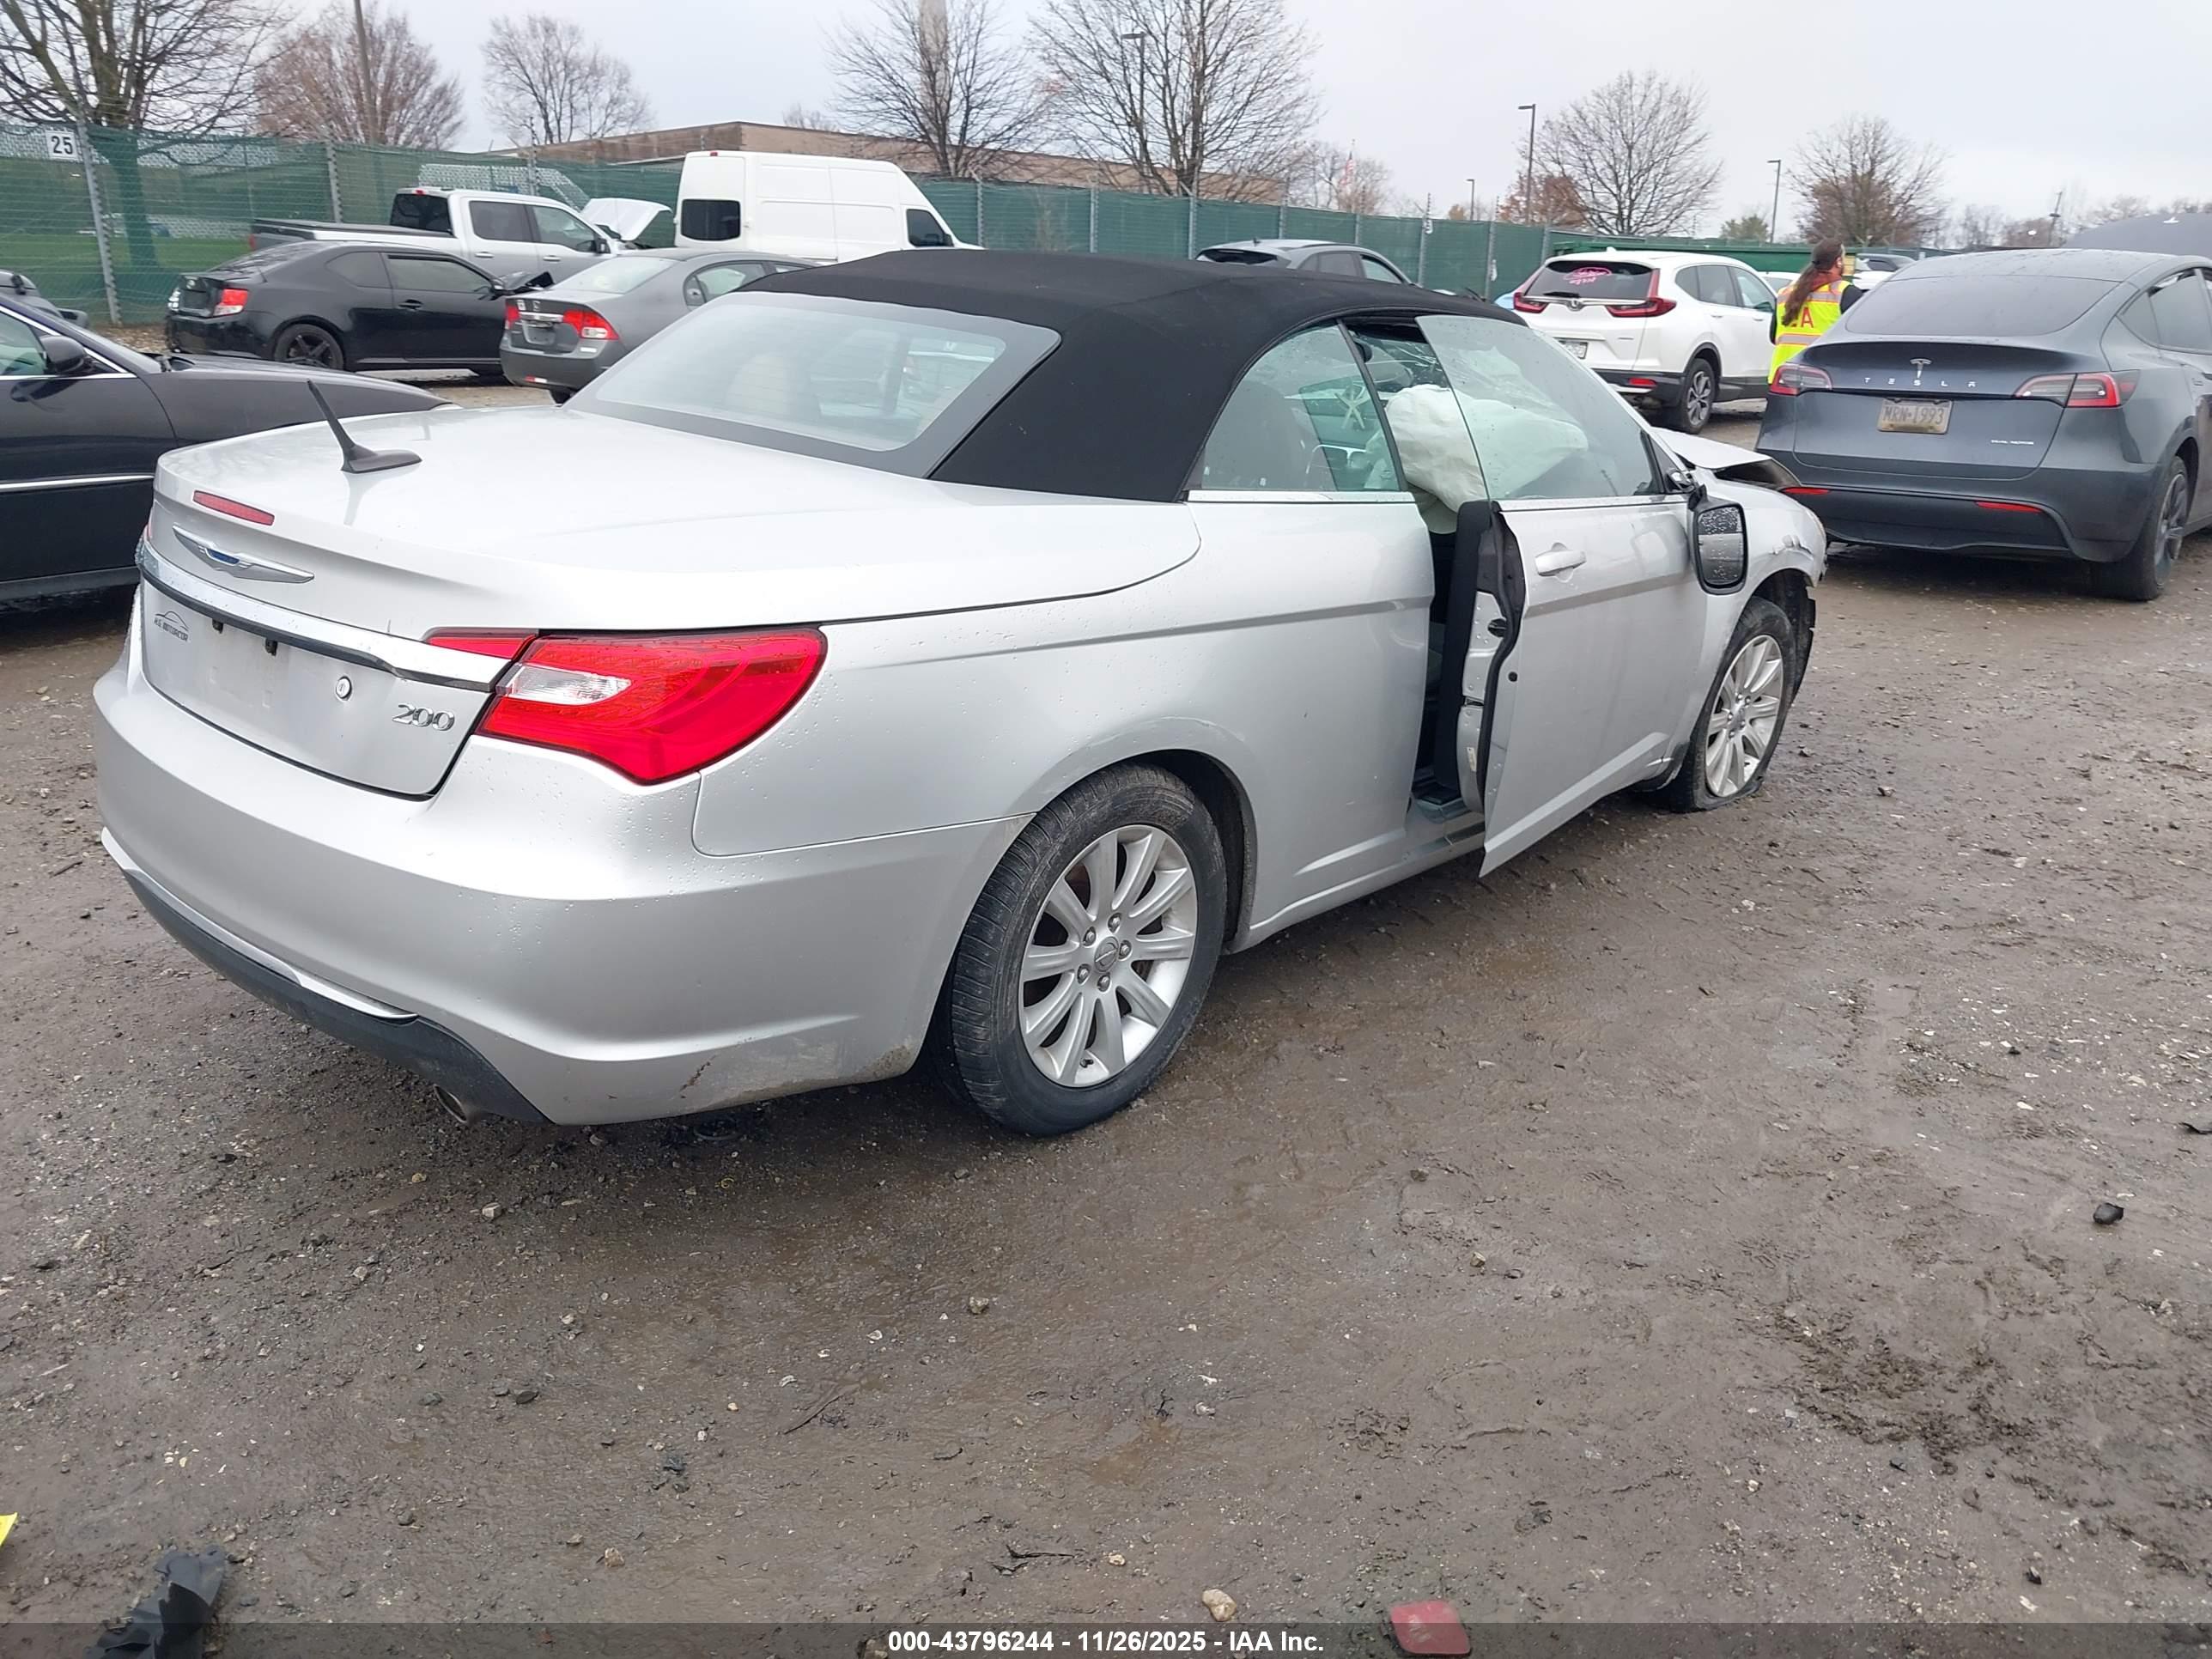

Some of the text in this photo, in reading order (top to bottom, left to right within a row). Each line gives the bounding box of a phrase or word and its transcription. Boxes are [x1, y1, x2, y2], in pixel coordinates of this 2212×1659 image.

[51, 136, 73, 155] 25
[1863, 377, 1976, 387] TESLA
[392, 702, 455, 731] 200
